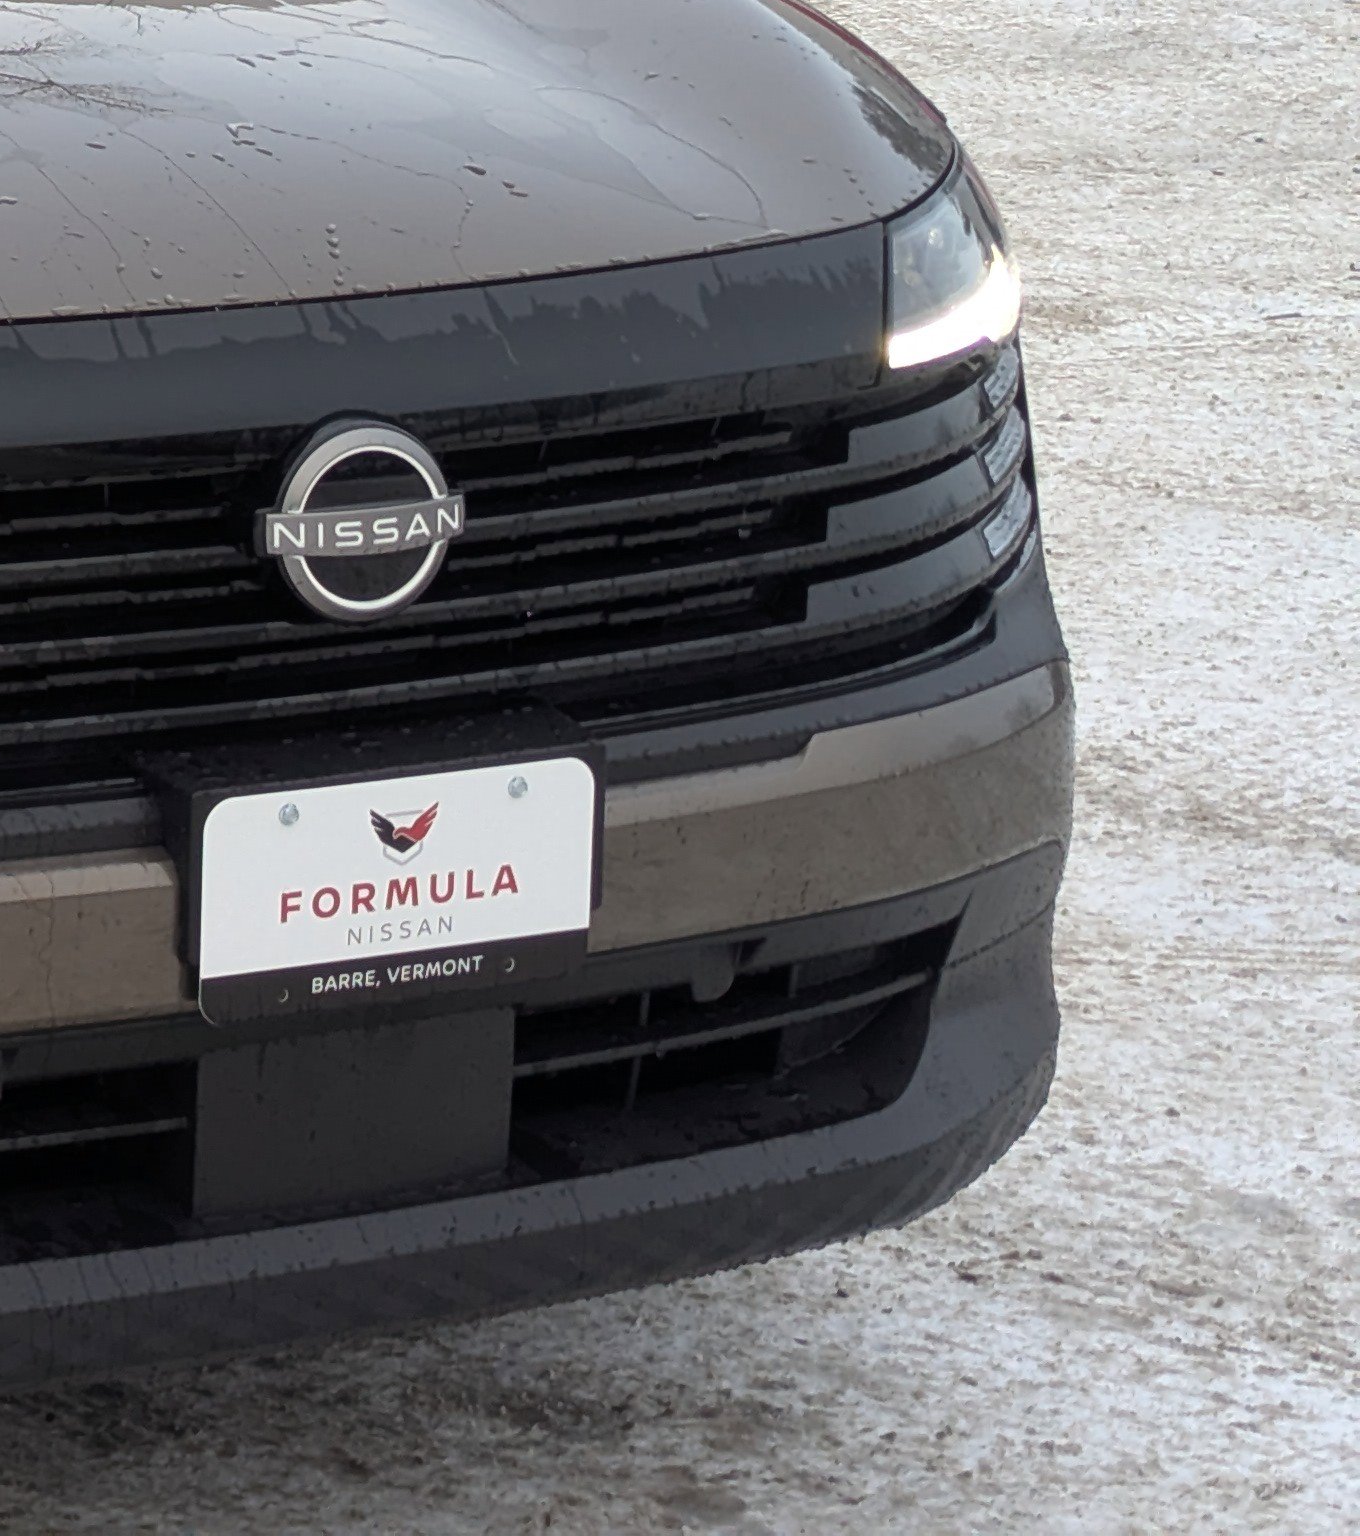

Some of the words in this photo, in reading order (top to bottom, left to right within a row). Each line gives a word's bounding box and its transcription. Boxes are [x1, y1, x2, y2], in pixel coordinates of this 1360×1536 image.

[273, 504, 459, 549] NISSAN
[280, 863, 519, 924] FORMULA
[347, 916, 454, 946] NISSAN
[311, 969, 381, 995] BARRE,
[387, 955, 485, 985] VERMONT
